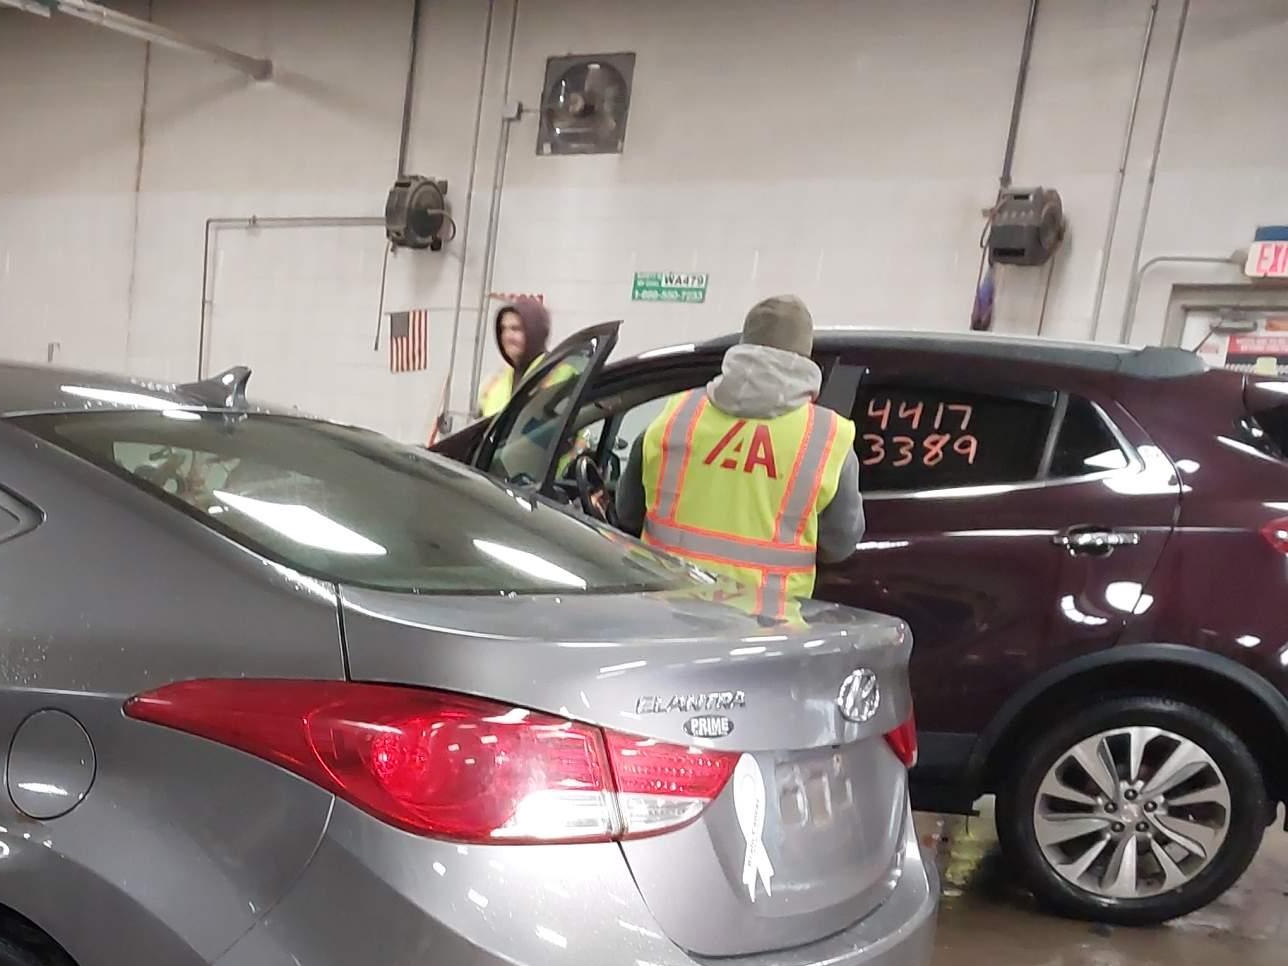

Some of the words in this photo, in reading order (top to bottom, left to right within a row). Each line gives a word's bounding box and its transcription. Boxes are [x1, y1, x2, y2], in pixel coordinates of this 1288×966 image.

[867, 399, 972, 430] 4417
[862, 433, 978, 466] 3389
[635, 690, 746, 714] ELANTRA
[690, 717, 729, 736] PRIME
